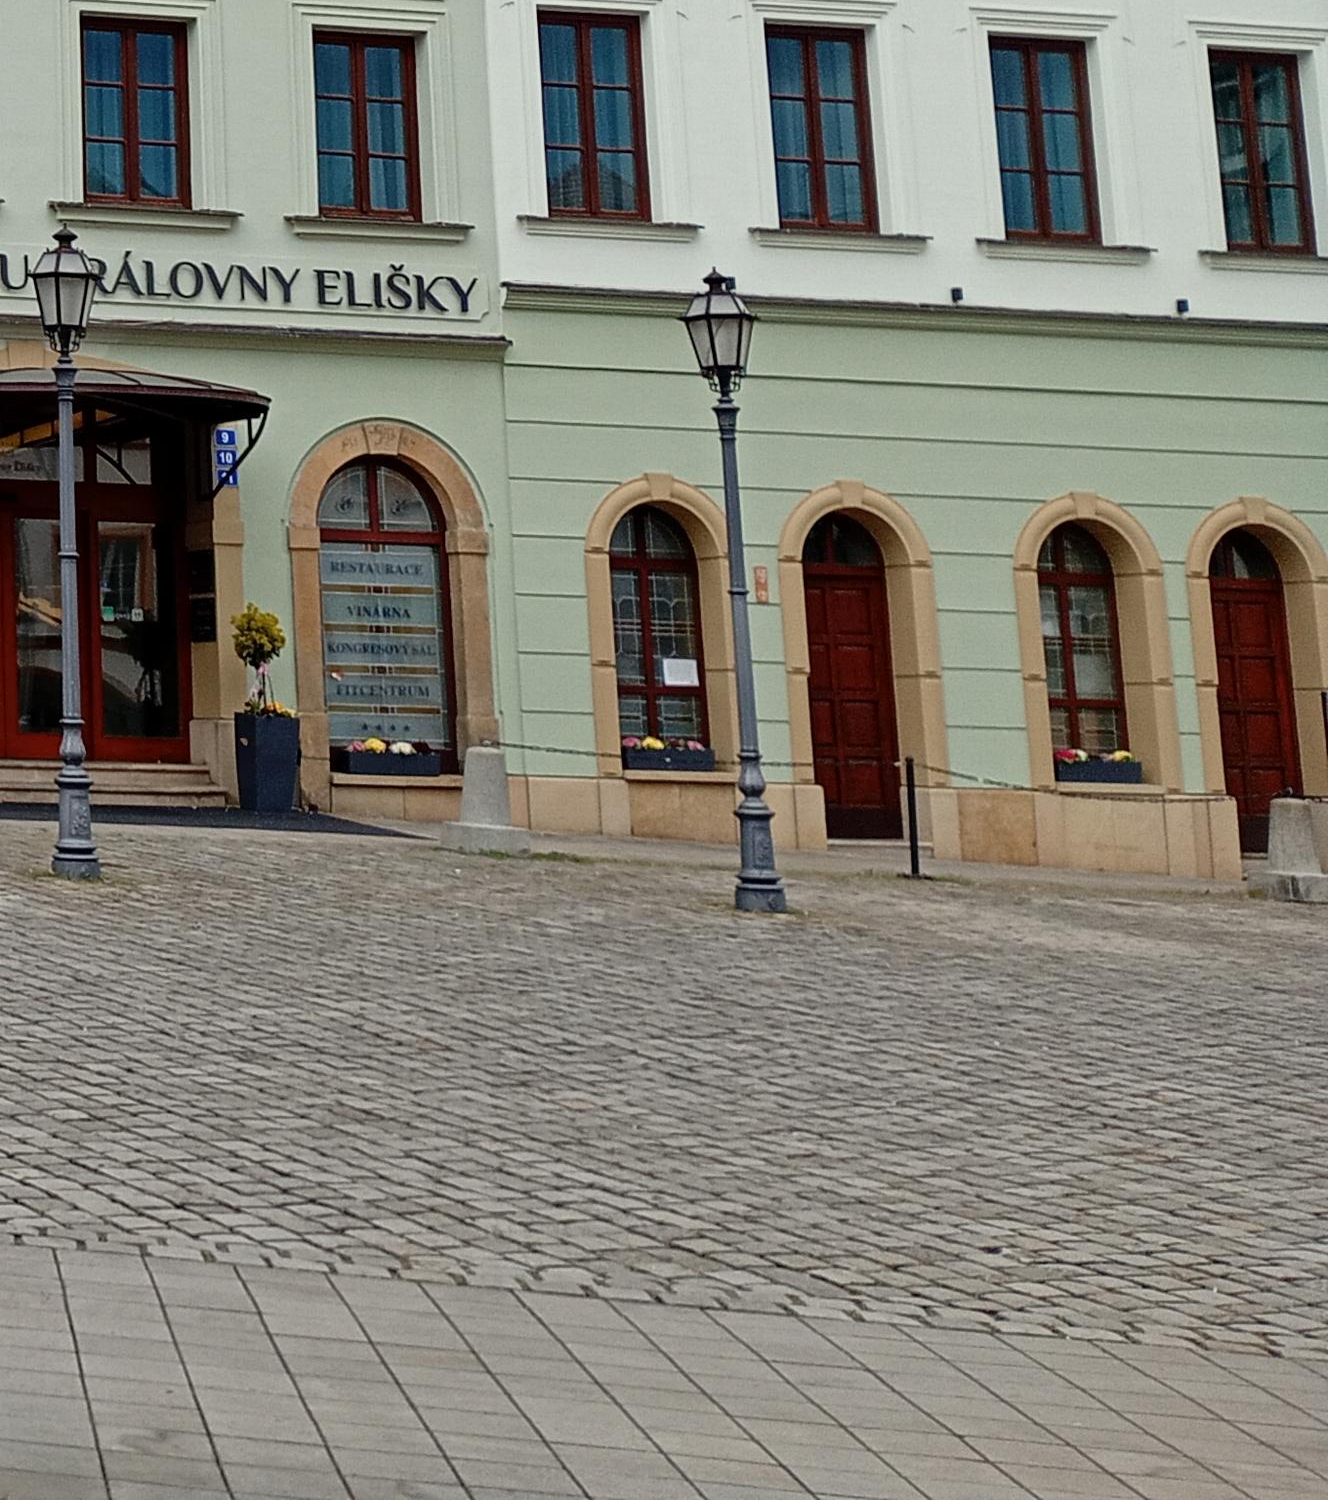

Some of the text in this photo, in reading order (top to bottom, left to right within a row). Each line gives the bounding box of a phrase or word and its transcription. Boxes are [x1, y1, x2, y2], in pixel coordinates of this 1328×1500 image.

[88, 250, 301, 304] RÁLOVNY
[313, 263, 478, 314] ELIŠKY
[221, 431, 230, 444] 9
[219, 451, 234, 465] 10
[330, 560, 423, 576] RESTAURACE
[346, 604, 412, 619] VINÁRNA
[336, 683, 430, 698] FITCENTRUM
